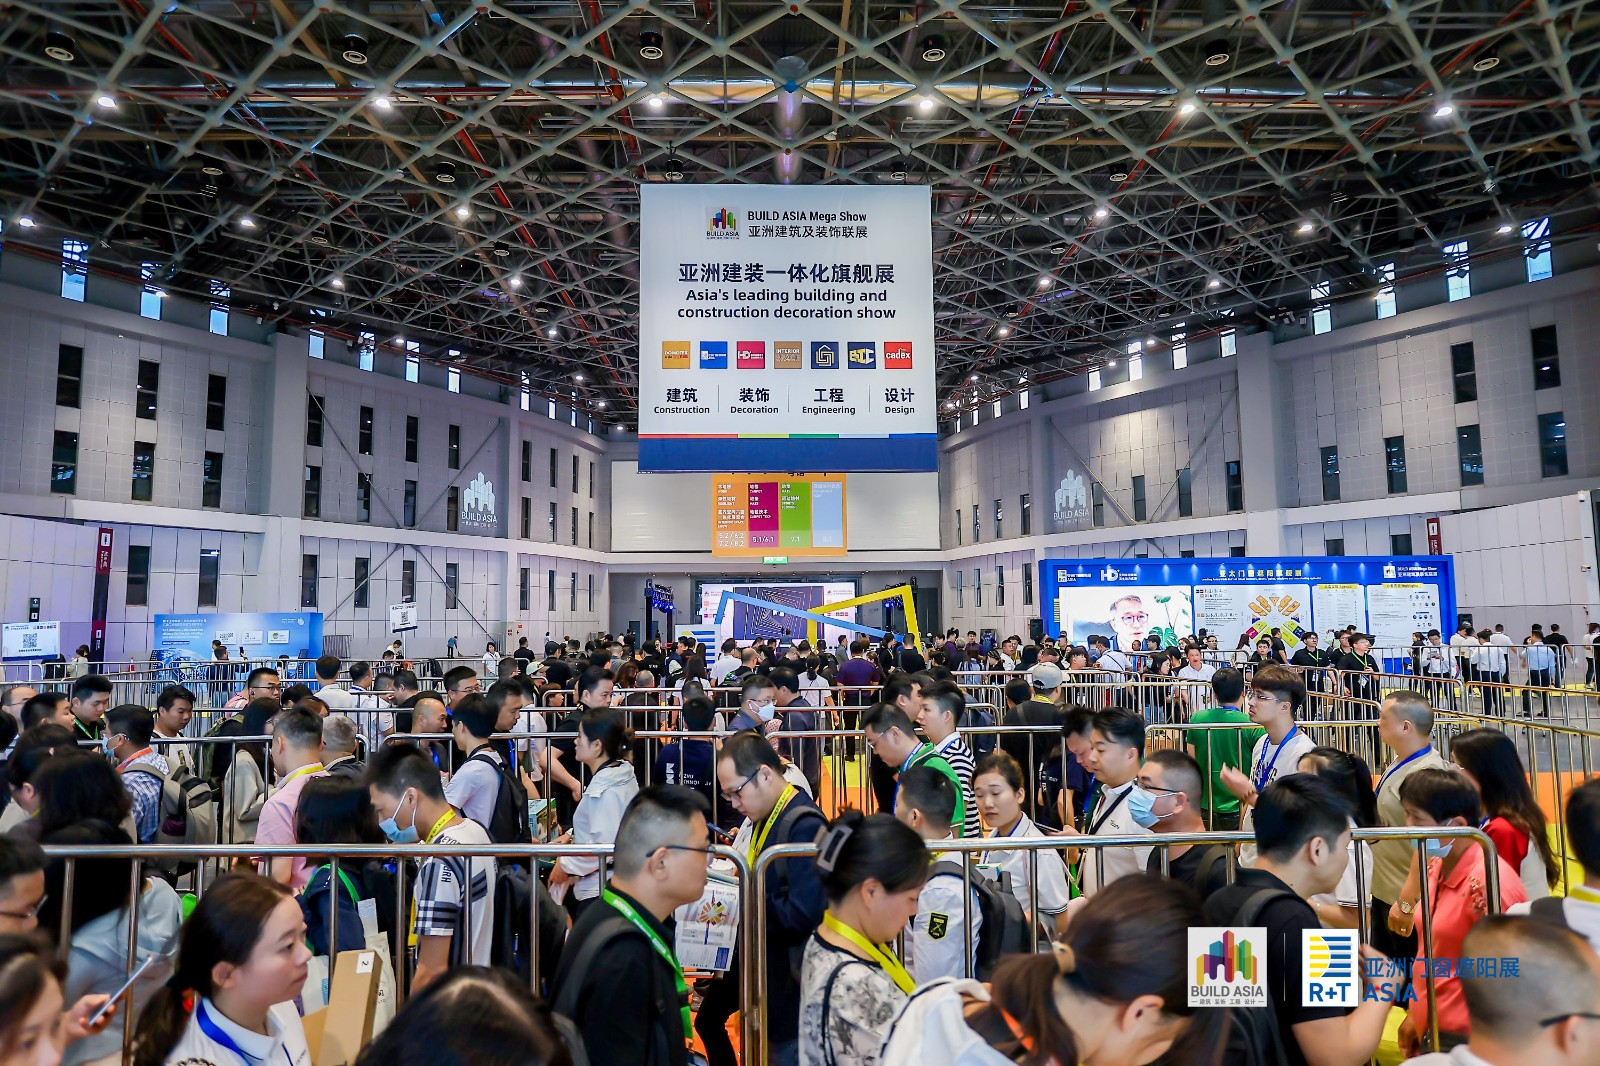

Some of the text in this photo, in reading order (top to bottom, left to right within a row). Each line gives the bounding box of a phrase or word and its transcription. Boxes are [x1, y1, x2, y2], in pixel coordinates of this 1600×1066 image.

[748, 211, 866, 223] BUILD ASIA Mega Show
[748, 225, 868, 239] 亚洲建筑及装饰联展
[679, 263, 895, 283] 亚洲建装一体化旗舰展
[686, 288, 887, 304] Asia's leading building and
[677, 306, 896, 319] construction decoration show
[885, 347, 911, 359] cadex
[667, 388, 915, 403] 建筑 装饰 工程 设计
[654, 405, 915, 416] Construction Decoration Engineering Design
[461, 511, 498, 523] BUILD ASIA
[1053, 508, 1090, 520] BUILD ASIA
